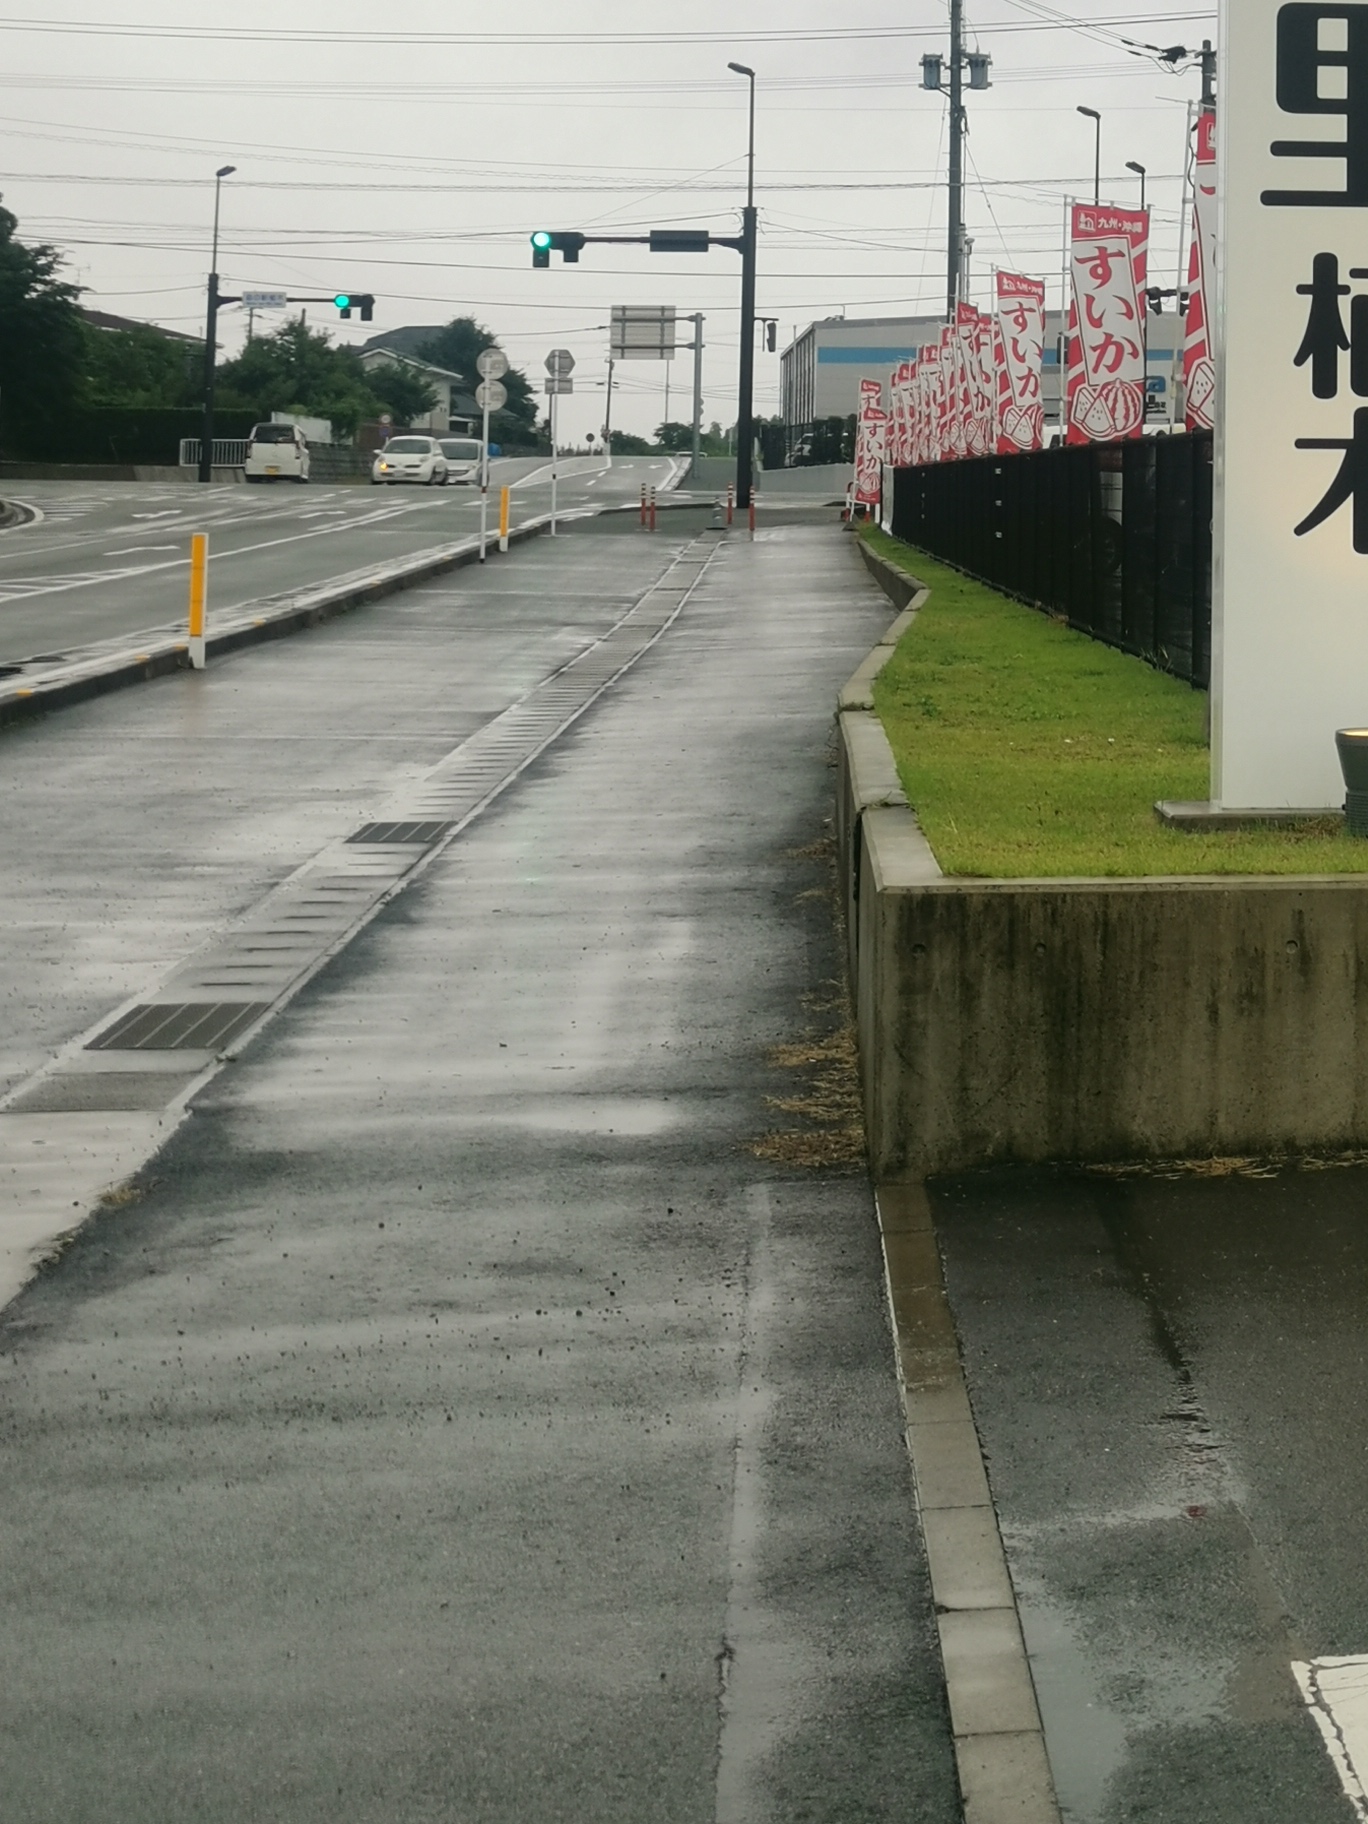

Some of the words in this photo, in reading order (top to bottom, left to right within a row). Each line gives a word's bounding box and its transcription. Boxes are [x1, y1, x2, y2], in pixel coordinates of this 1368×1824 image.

[1001, 301, 1044, 398] すいか
[1074, 246, 1140, 374] すいか
[864, 422, 884, 470] すいか
